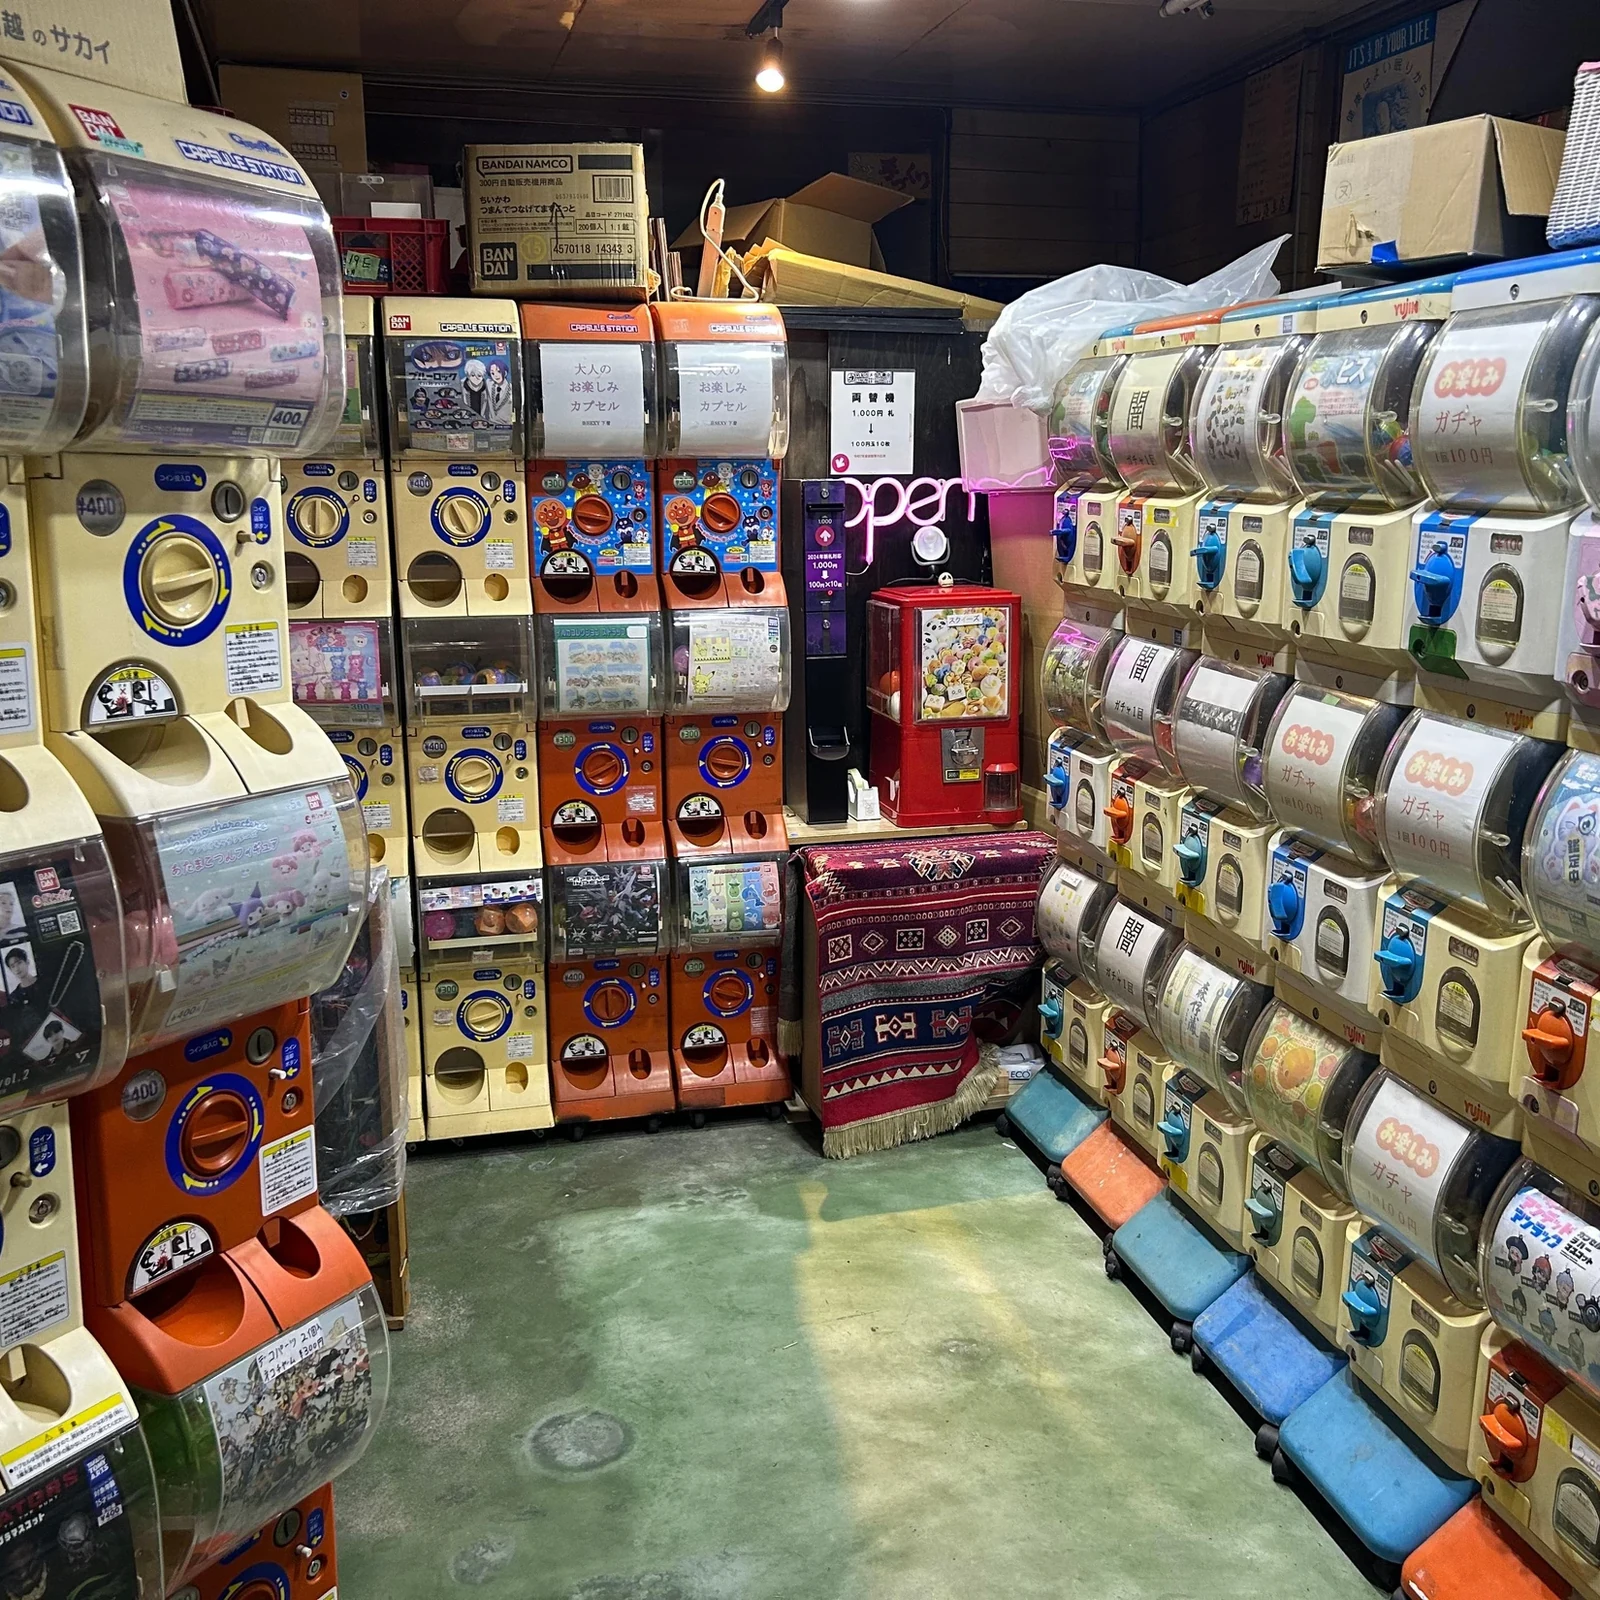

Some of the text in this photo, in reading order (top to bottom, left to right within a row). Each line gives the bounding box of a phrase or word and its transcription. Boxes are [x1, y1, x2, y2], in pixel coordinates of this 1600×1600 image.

[1409, 19, 1430, 45] LIFE
[482, 159, 568, 170] BANDAI NAMCO
[479, 195, 511, 204] ちいかわ
[483, 248, 515, 262] BAN
[627, 244, 633, 254] 3
[484, 261, 509, 276] DAI
[574, 362, 612, 376] 大人の
[1438, 364, 1501, 391] お楽しみ
[569, 380, 619, 393] お楽しみ
[699, 381, 748, 394] お楽しみ
[570, 400, 620, 413] カプセル
[700, 401, 748, 413] カプセル
[1434, 410, 1483, 436] ガチャ
[424, 742, 446, 751] ¥400
[1284, 729, 1331, 759] お楽しみ
[1281, 763, 1316, 794] ガチャ
[1408, 756, 1468, 788] お楽しみ
[1400, 795, 1446, 830] ガチャ
[437, 985, 457, 994] ¥300
[1379, 1121, 1434, 1171] お楽しみ
[1370, 1160, 1413, 1205] ガチャ
